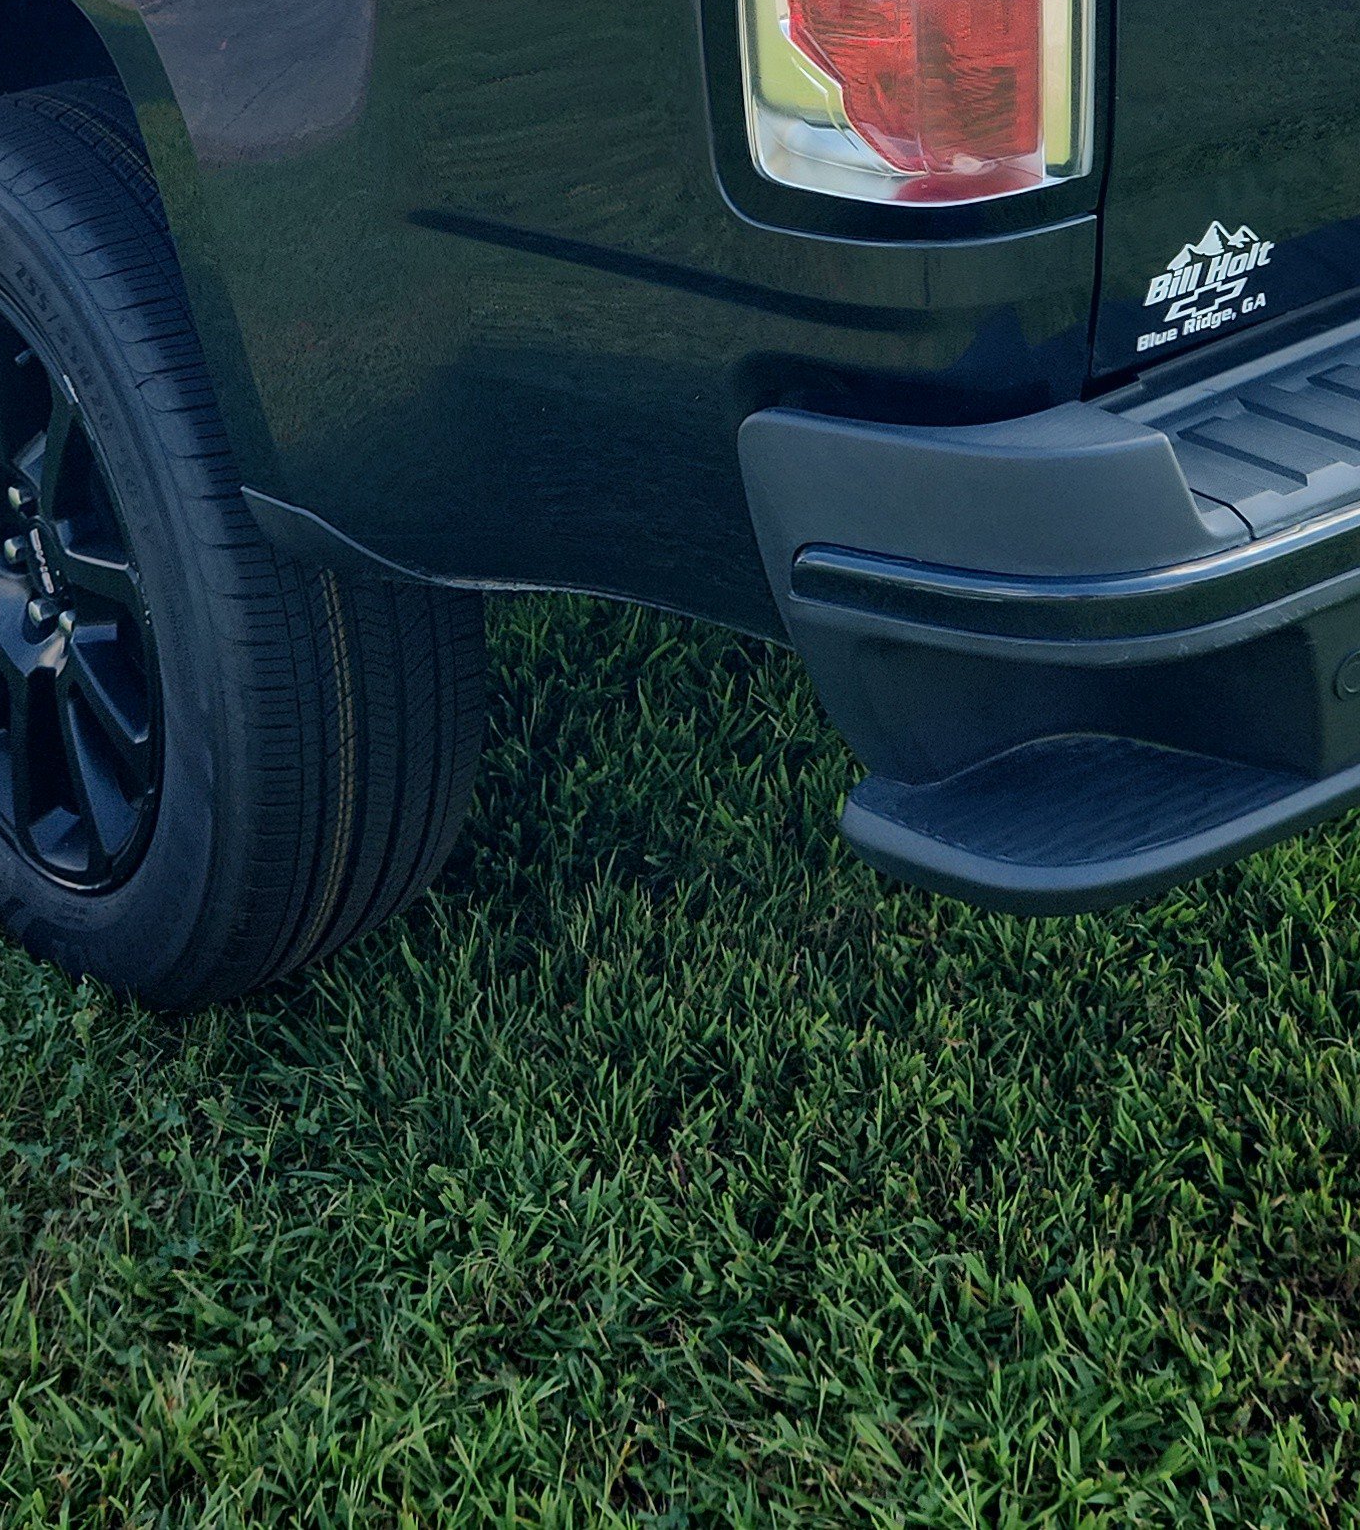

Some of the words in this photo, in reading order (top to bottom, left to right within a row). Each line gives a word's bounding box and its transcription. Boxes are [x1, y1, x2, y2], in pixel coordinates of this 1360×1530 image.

[1143, 261, 1204, 307] Bill
[1205, 240, 1276, 285] Holt
[1136, 327, 1178, 352] Blue
[1182, 307, 1237, 336] Ridge,
[1241, 292, 1267, 314] GA
